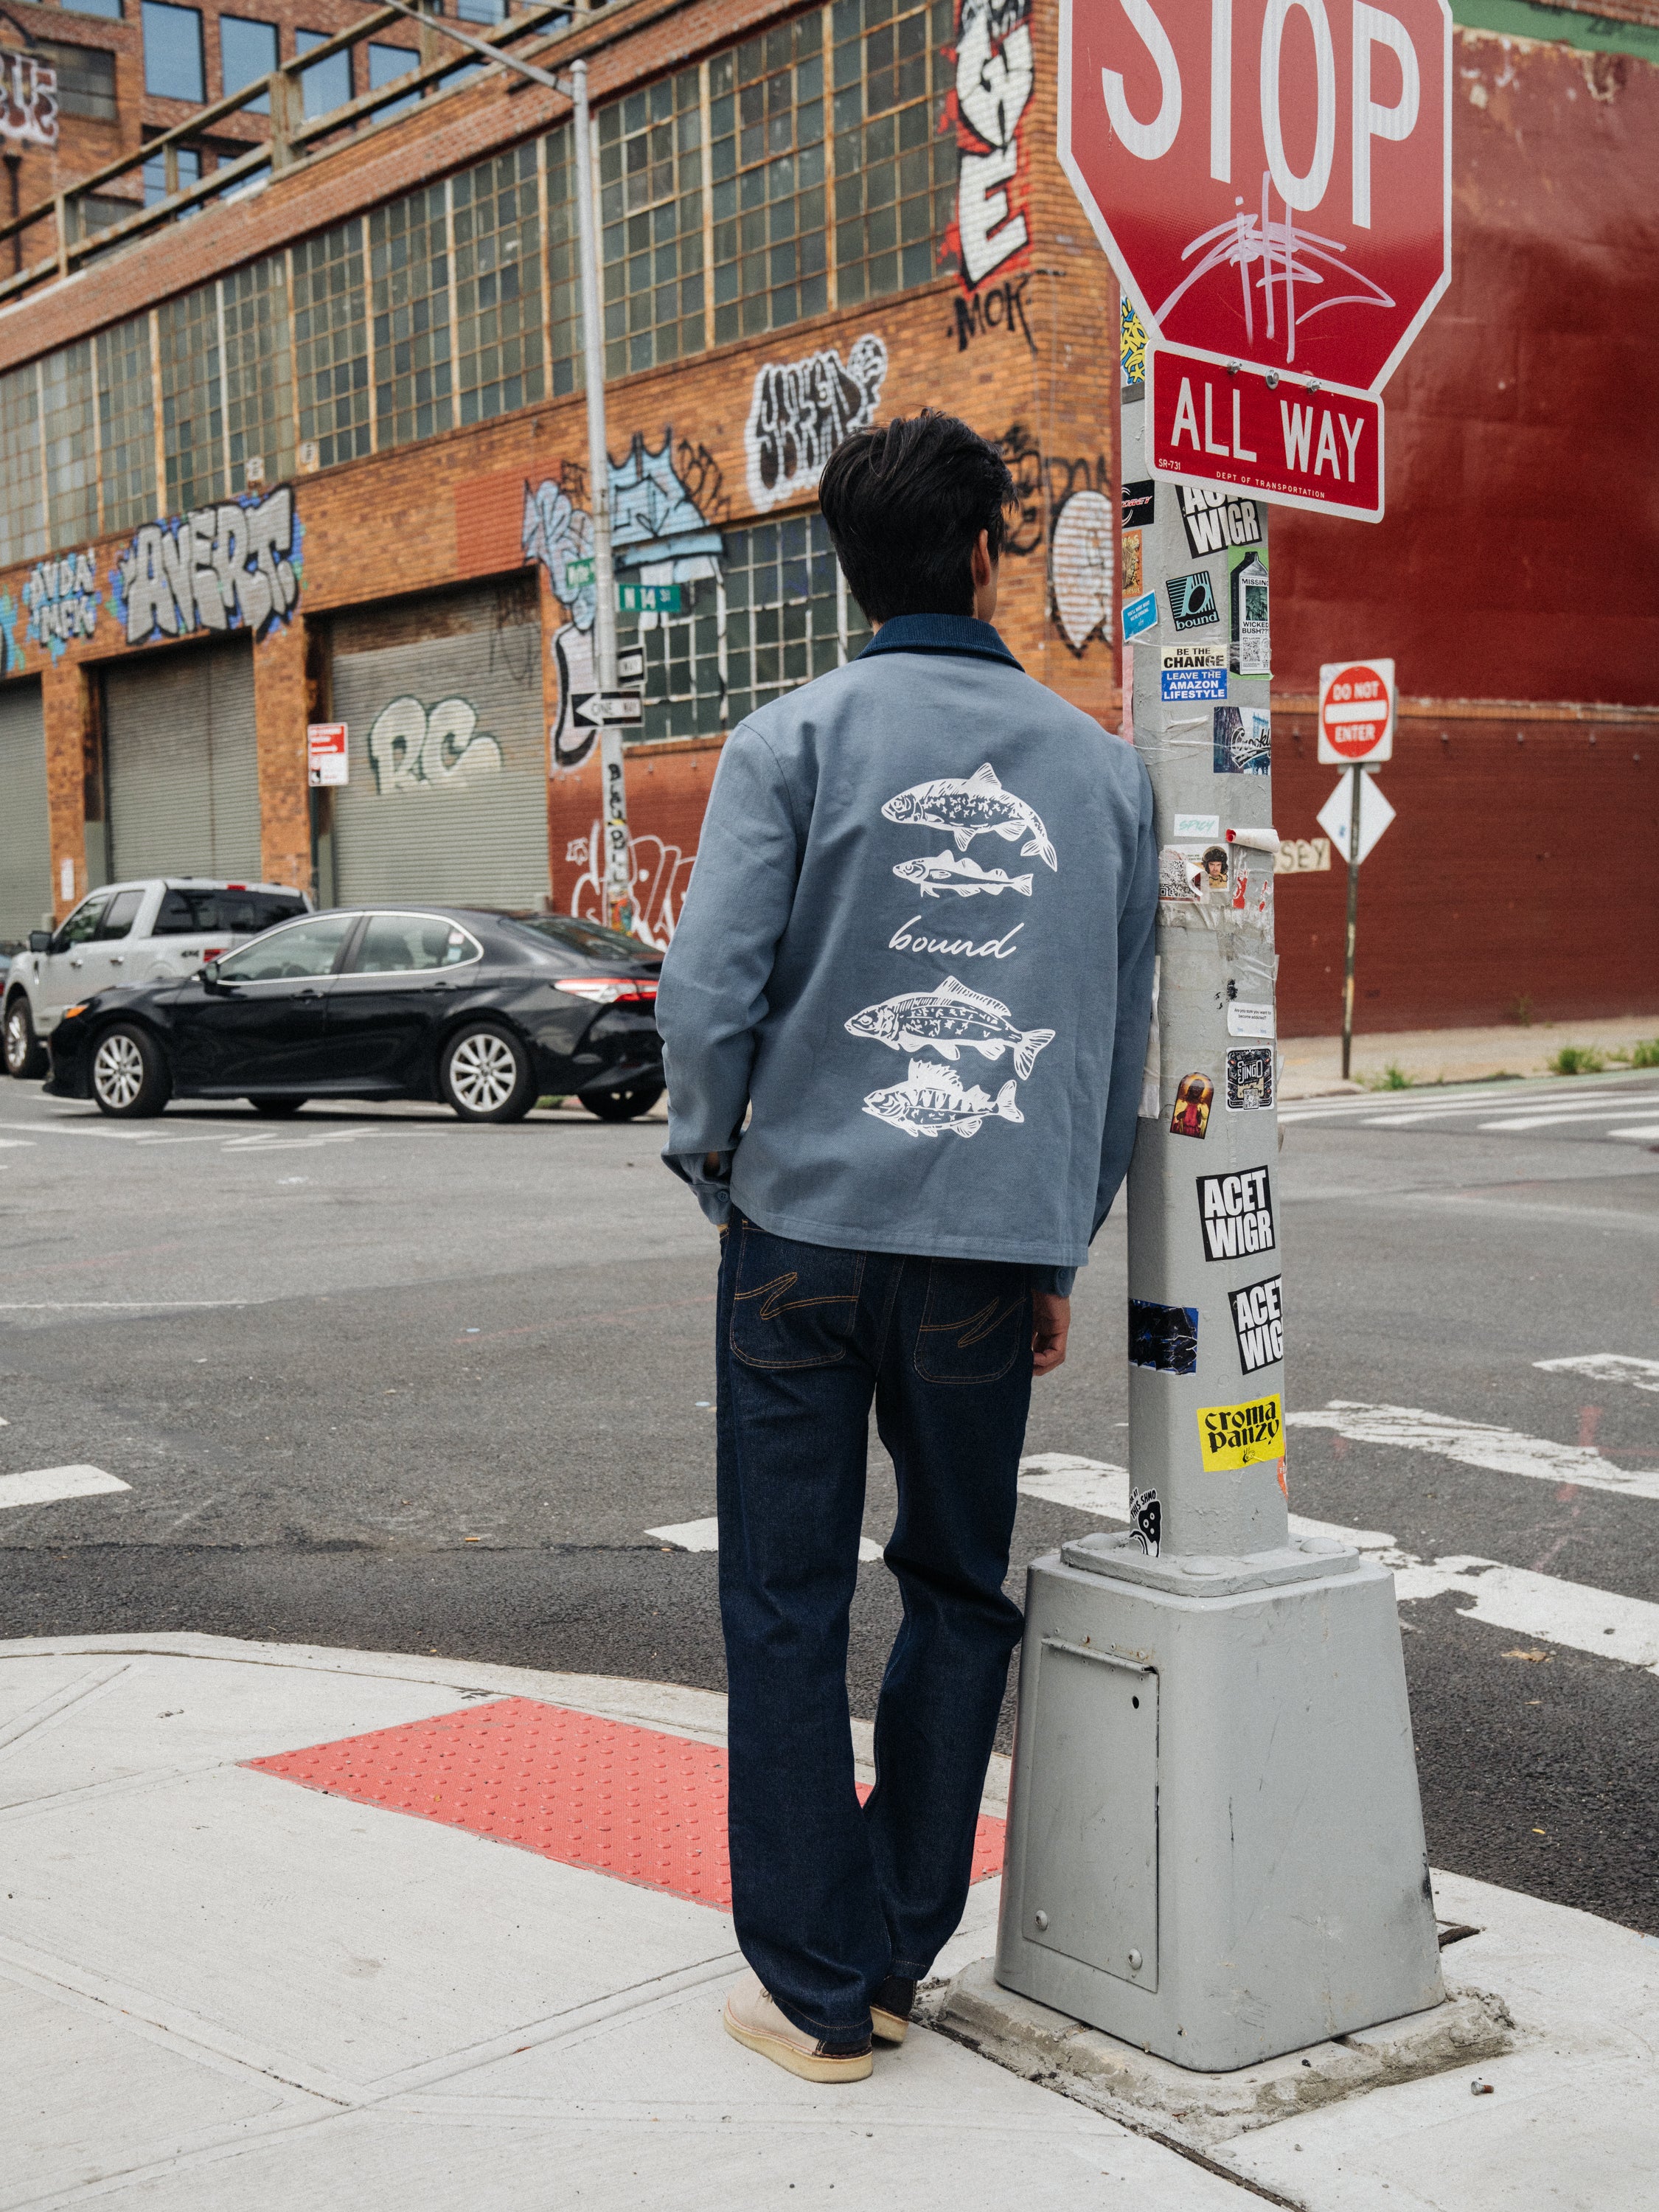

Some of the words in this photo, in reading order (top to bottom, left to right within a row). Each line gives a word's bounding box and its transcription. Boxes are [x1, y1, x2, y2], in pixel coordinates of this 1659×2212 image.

[1171, 377, 1256, 462] ALL
[1280, 400, 1364, 482] WAY
[1158, 458, 1180, 470] SR-731
[1217, 471, 1237, 481] DEPT
[1241, 476, 1251, 484] OF
[1256, 479, 1325, 498] TRANSPORTATION
[1186, 501, 1259, 554] WIGR
[625, 588, 635, 608] N
[641, 588, 656, 609] 14
[1176, 611, 1218, 630] bound
[1164, 655, 1225, 668] CHANGE
[1166, 672, 1198, 680] LEAVE
[1169, 681, 1219, 690] AMAZON
[1164, 689, 1225, 699] LIFESTYLE
[1333, 683, 1352, 700] DO
[1354, 681, 1380, 698] NOT
[1335, 723, 1376, 743] ENTER
[1274, 841, 1326, 871] SEY
[888, 915, 1024, 959] bound
[1204, 1169, 1266, 1218] ACET
[1205, 1210, 1273, 1259] WIGR
[1205, 1401, 1276, 1431] croma
[1208, 1419, 1279, 1453] panzy
[1130, 1500, 1141, 1519] THIS
